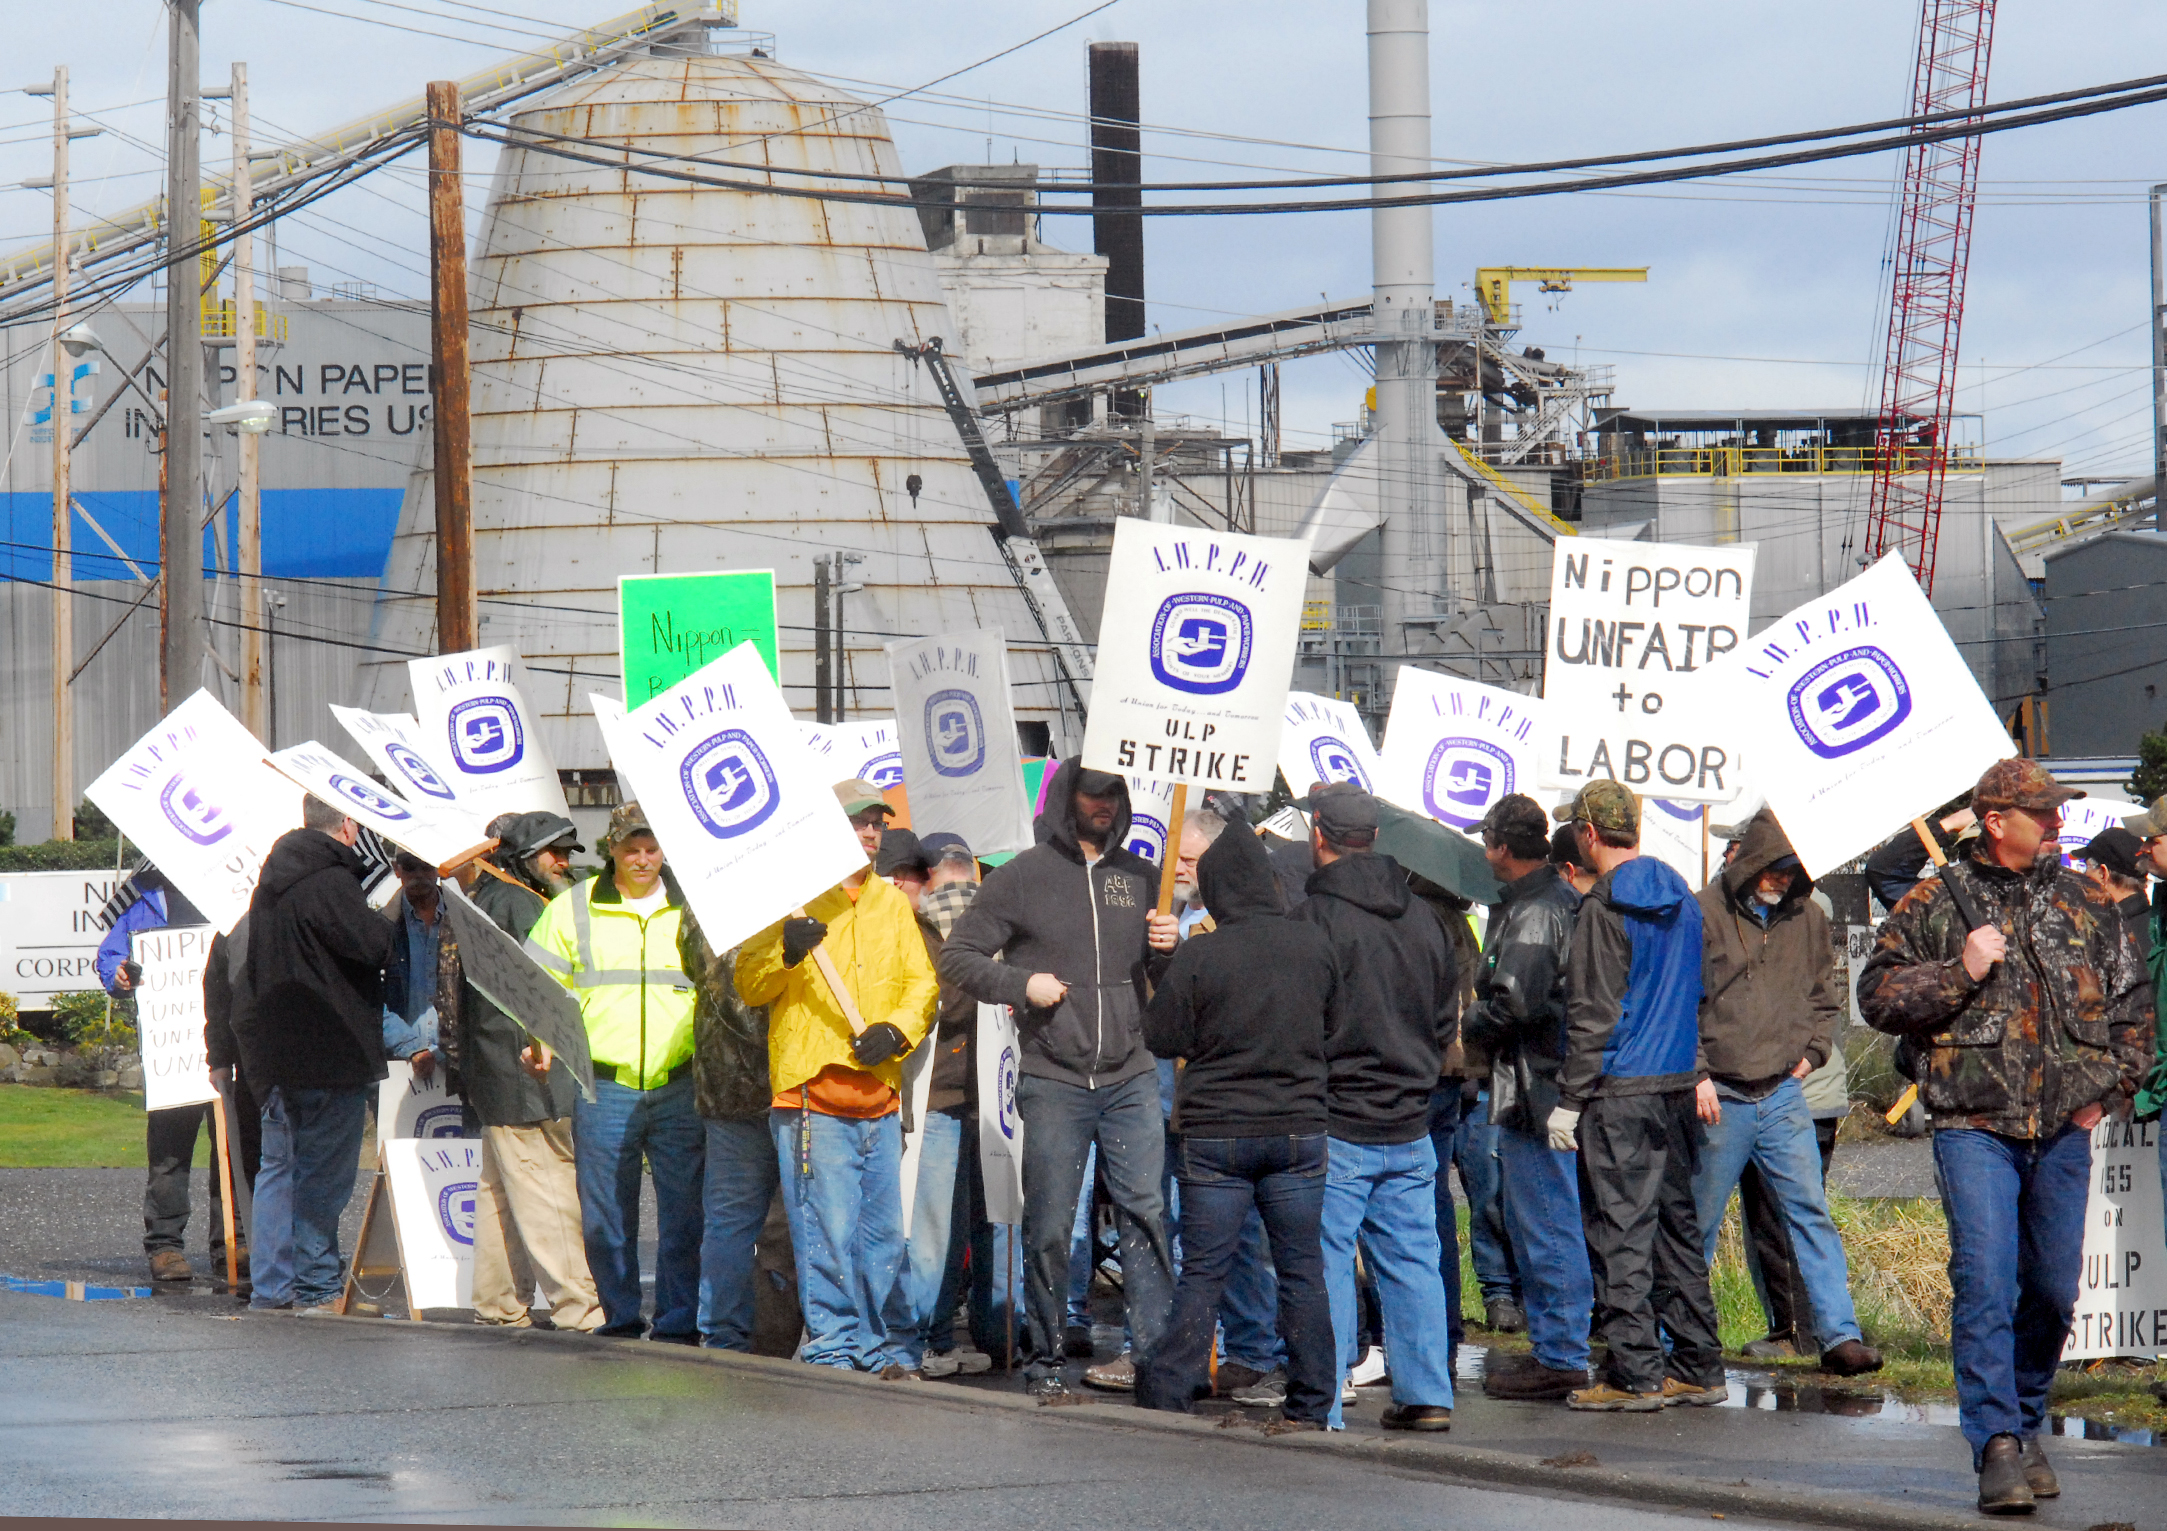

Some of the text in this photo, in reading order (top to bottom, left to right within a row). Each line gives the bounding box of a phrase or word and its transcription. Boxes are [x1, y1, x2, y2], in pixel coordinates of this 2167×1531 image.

[320, 364, 432, 395] PAPE
[1565, 553, 1742, 608] Nippon
[1173, 594, 1209, 604] WESTERN
[1209, 596, 1229, 606] PULP
[1229, 602, 1244, 614] AND
[651, 610, 734, 666] Nippon
[1056, 615, 1090, 678] PARSONS
[1794, 662, 1829, 692] WESTERN
[1828, 652, 1850, 667] PULP
[1851, 648, 1870, 658] AND
[1612, 683, 1663, 714] to
[711, 733, 727, 745] PULP
[727, 731, 740, 740] AND
[1165, 718, 1216, 742] ULP
[1117, 739, 1250, 782] STRIKE
[1559, 735, 1727, 790] LABOR
[2104, 1207, 2123, 1227] ON
[2087, 1251, 2142, 1290] ULP
